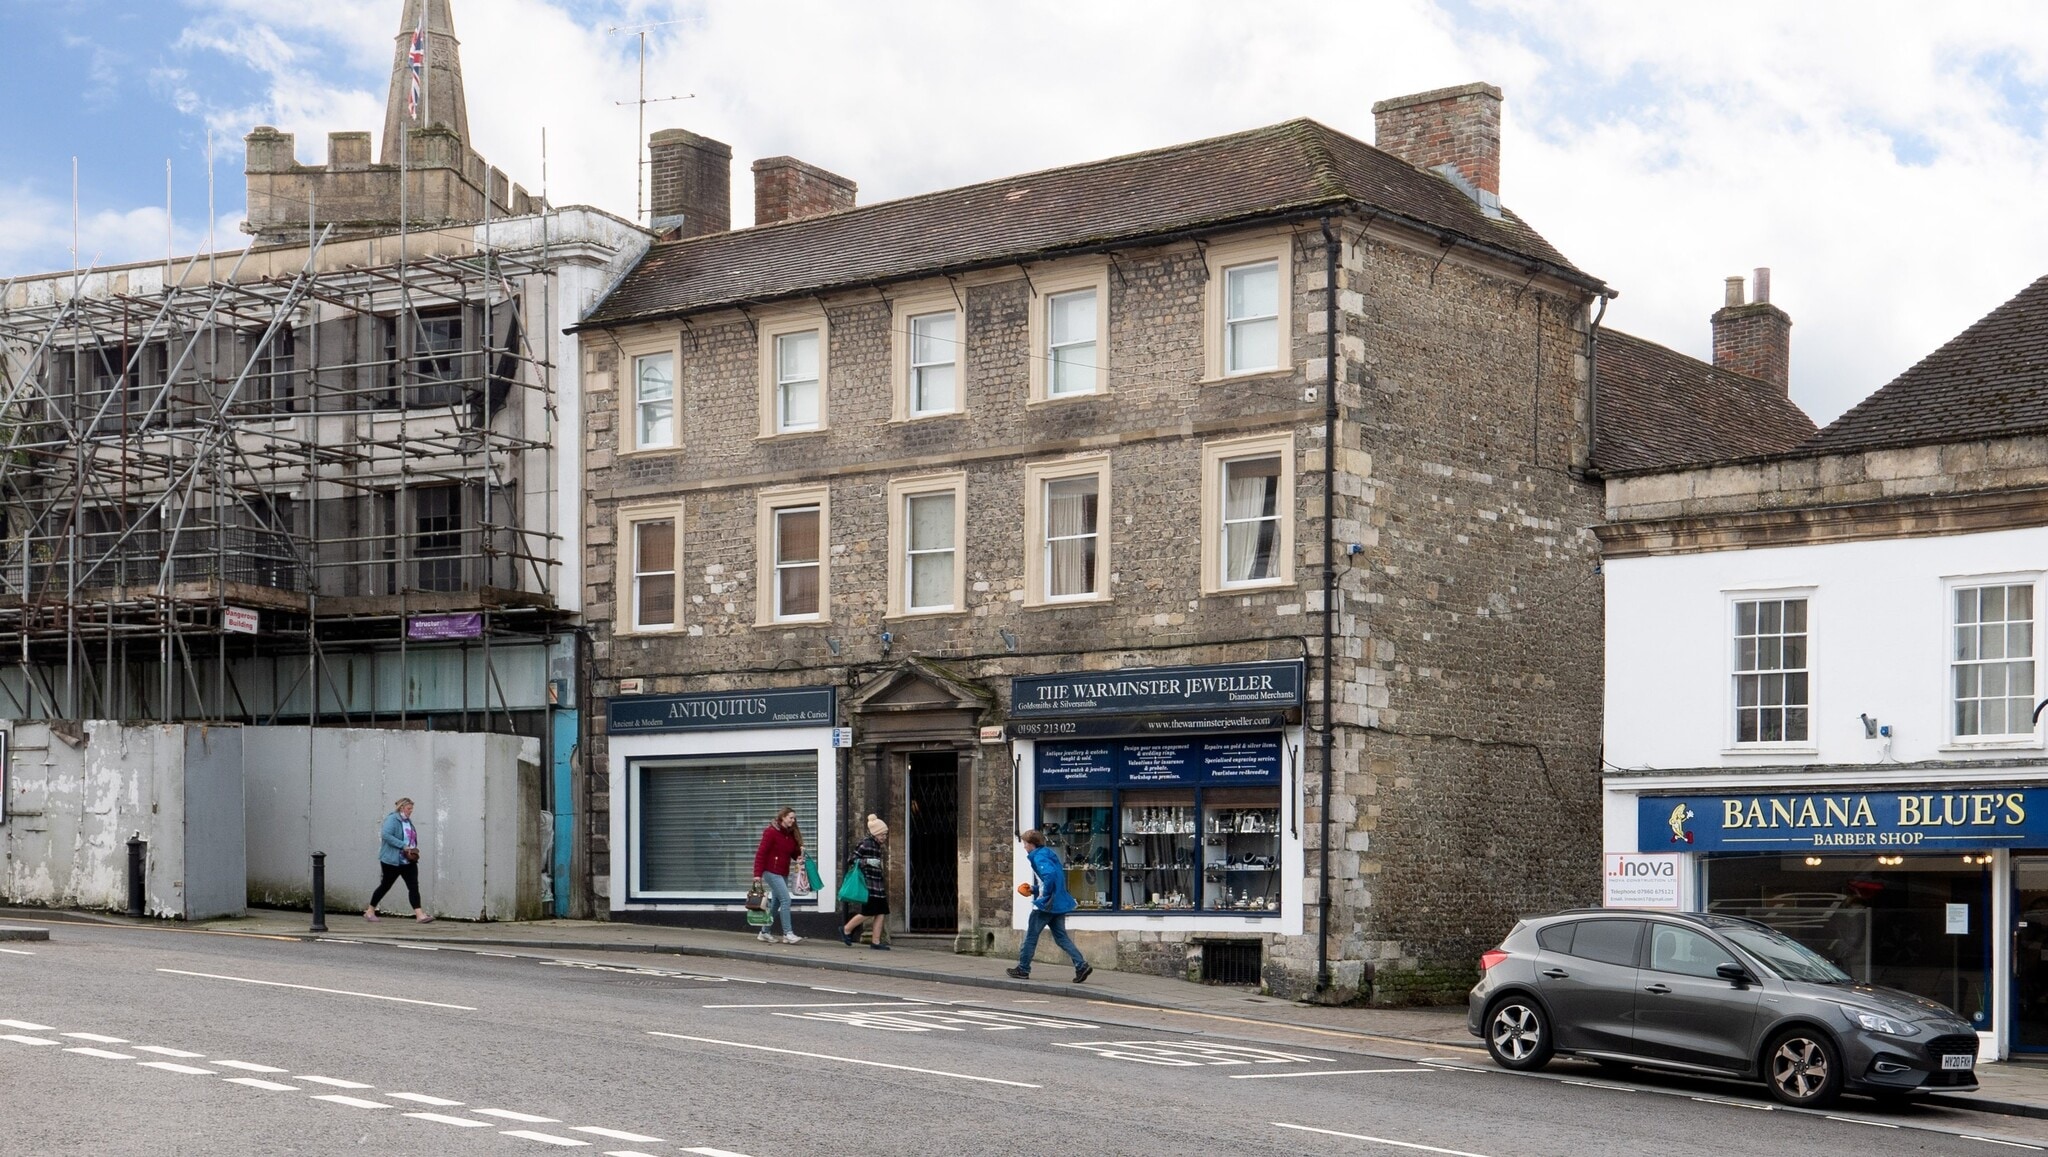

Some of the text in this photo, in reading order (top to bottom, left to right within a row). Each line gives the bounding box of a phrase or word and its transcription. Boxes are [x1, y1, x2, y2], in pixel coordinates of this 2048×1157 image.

[224, 609, 257, 620] Dangerous
[228, 618, 254, 630] Building
[1037, 675, 1274, 700] THE WARMINSTER JEWELLER
[1229, 690, 1294, 701] Diamond Merchants
[668, 698, 767, 720] ANTIQUITUS
[1018, 700, 1098, 710] Goldsmiths & Silversmiths
[772, 710, 828, 722] Antiques & Curios
[612, 718, 664, 728] Ancient & Modern
[1018, 722, 1076, 734] 01985 213 022
[1148, 716, 1270, 729] www.thewarminsterjeweller.com
[1722, 792, 2026, 829] BANANA BLUE'S
[1814, 832, 1924, 846] BARBER SHOP
[1944, 1056, 1960, 1067] HY20
